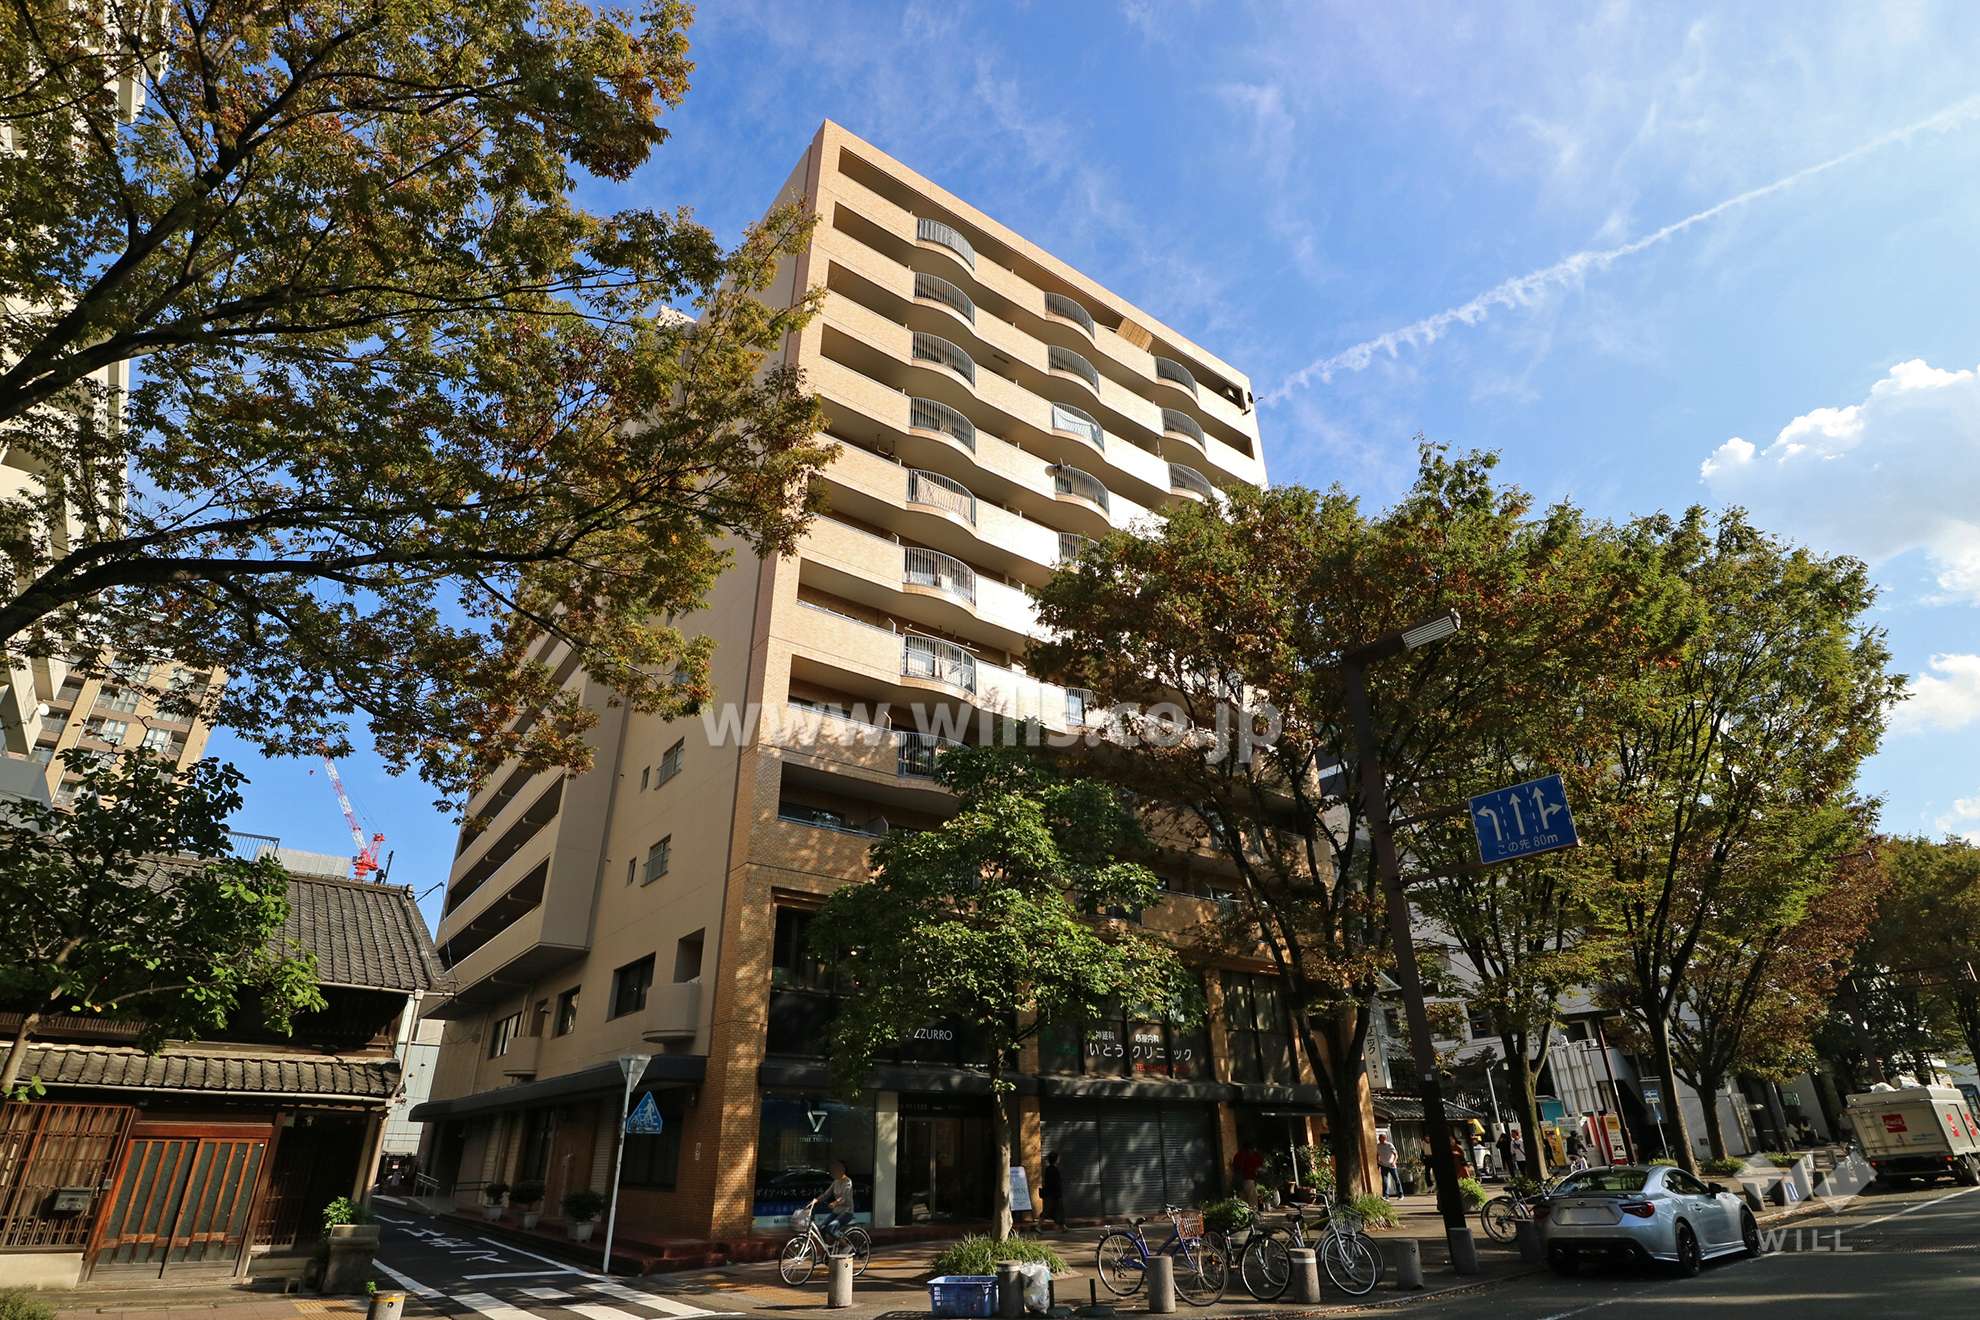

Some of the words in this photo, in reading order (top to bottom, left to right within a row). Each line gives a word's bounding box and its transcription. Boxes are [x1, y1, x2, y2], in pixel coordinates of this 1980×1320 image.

[1498, 839, 1531, 855] この先
[1533, 834, 1559, 848] 80m
